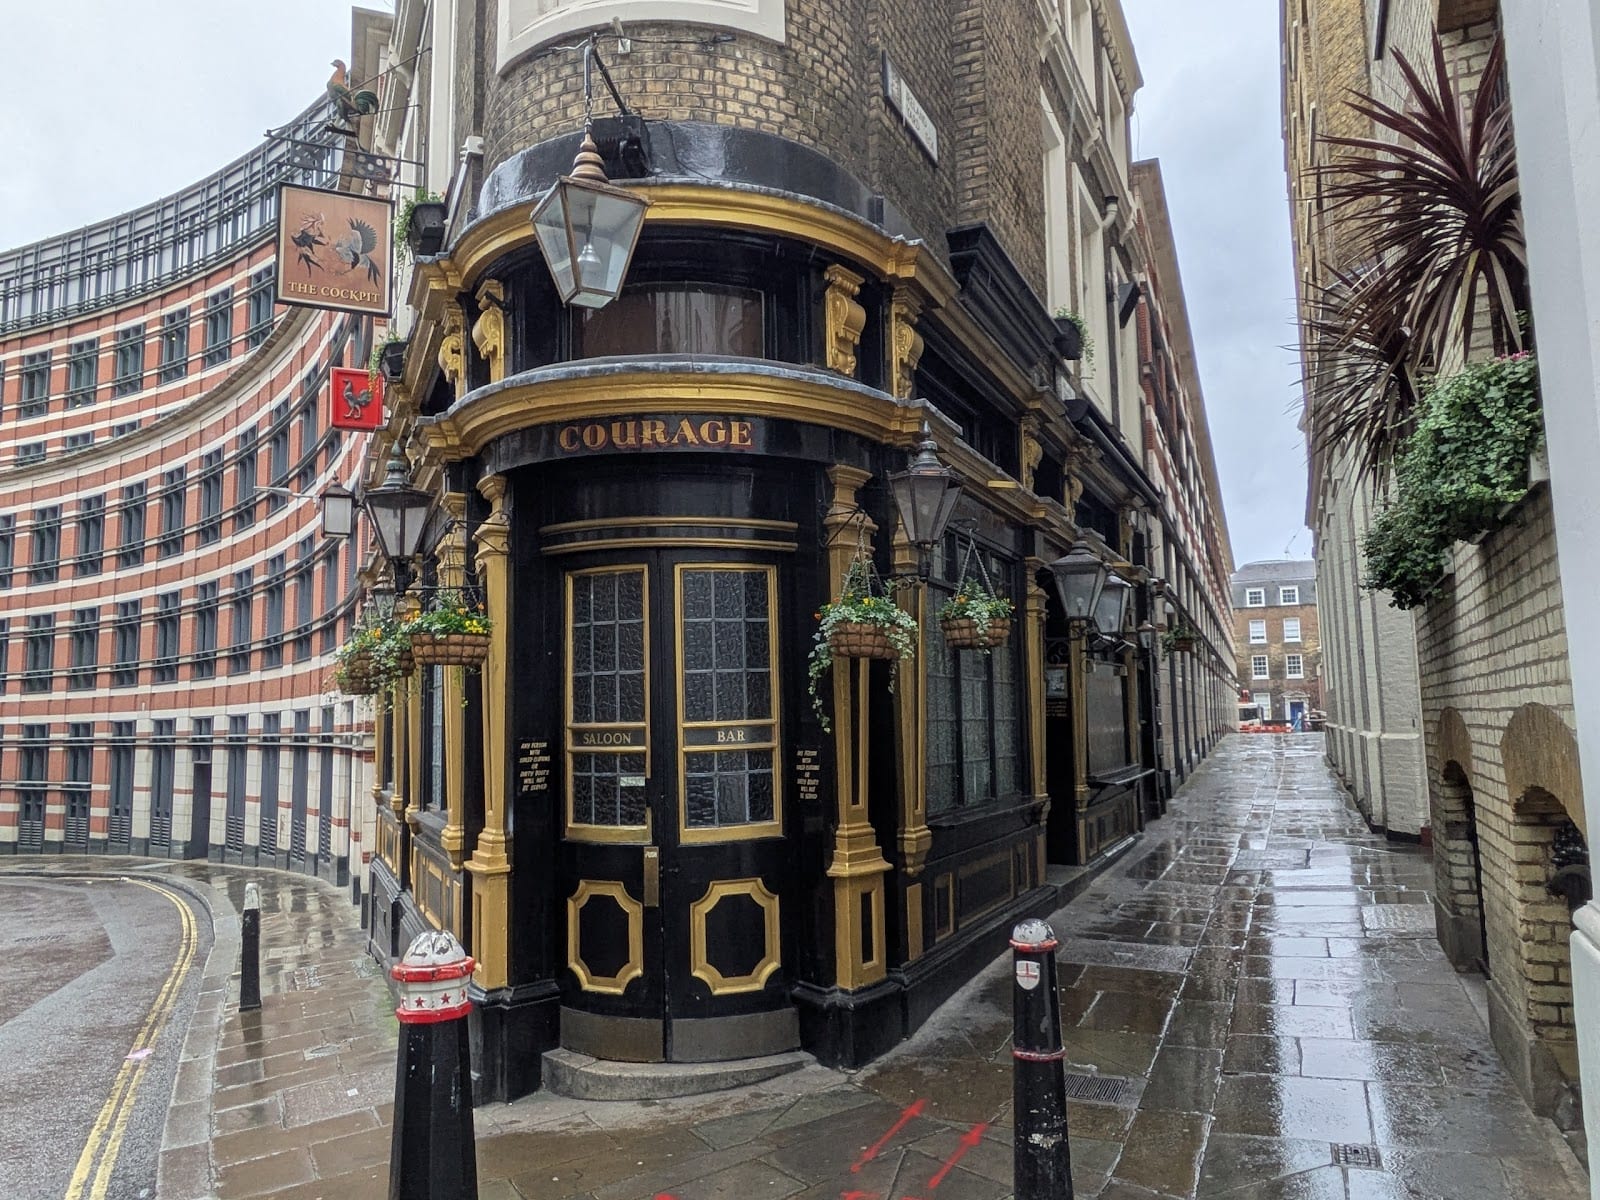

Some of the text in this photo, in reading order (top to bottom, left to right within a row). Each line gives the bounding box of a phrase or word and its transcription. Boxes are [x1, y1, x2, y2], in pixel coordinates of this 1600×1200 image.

[288, 281, 380, 303] THE COCKPIT
[559, 417, 753, 451] COURAGE
[583, 732, 631, 745] SALOON
[717, 730, 745, 742] BAR
